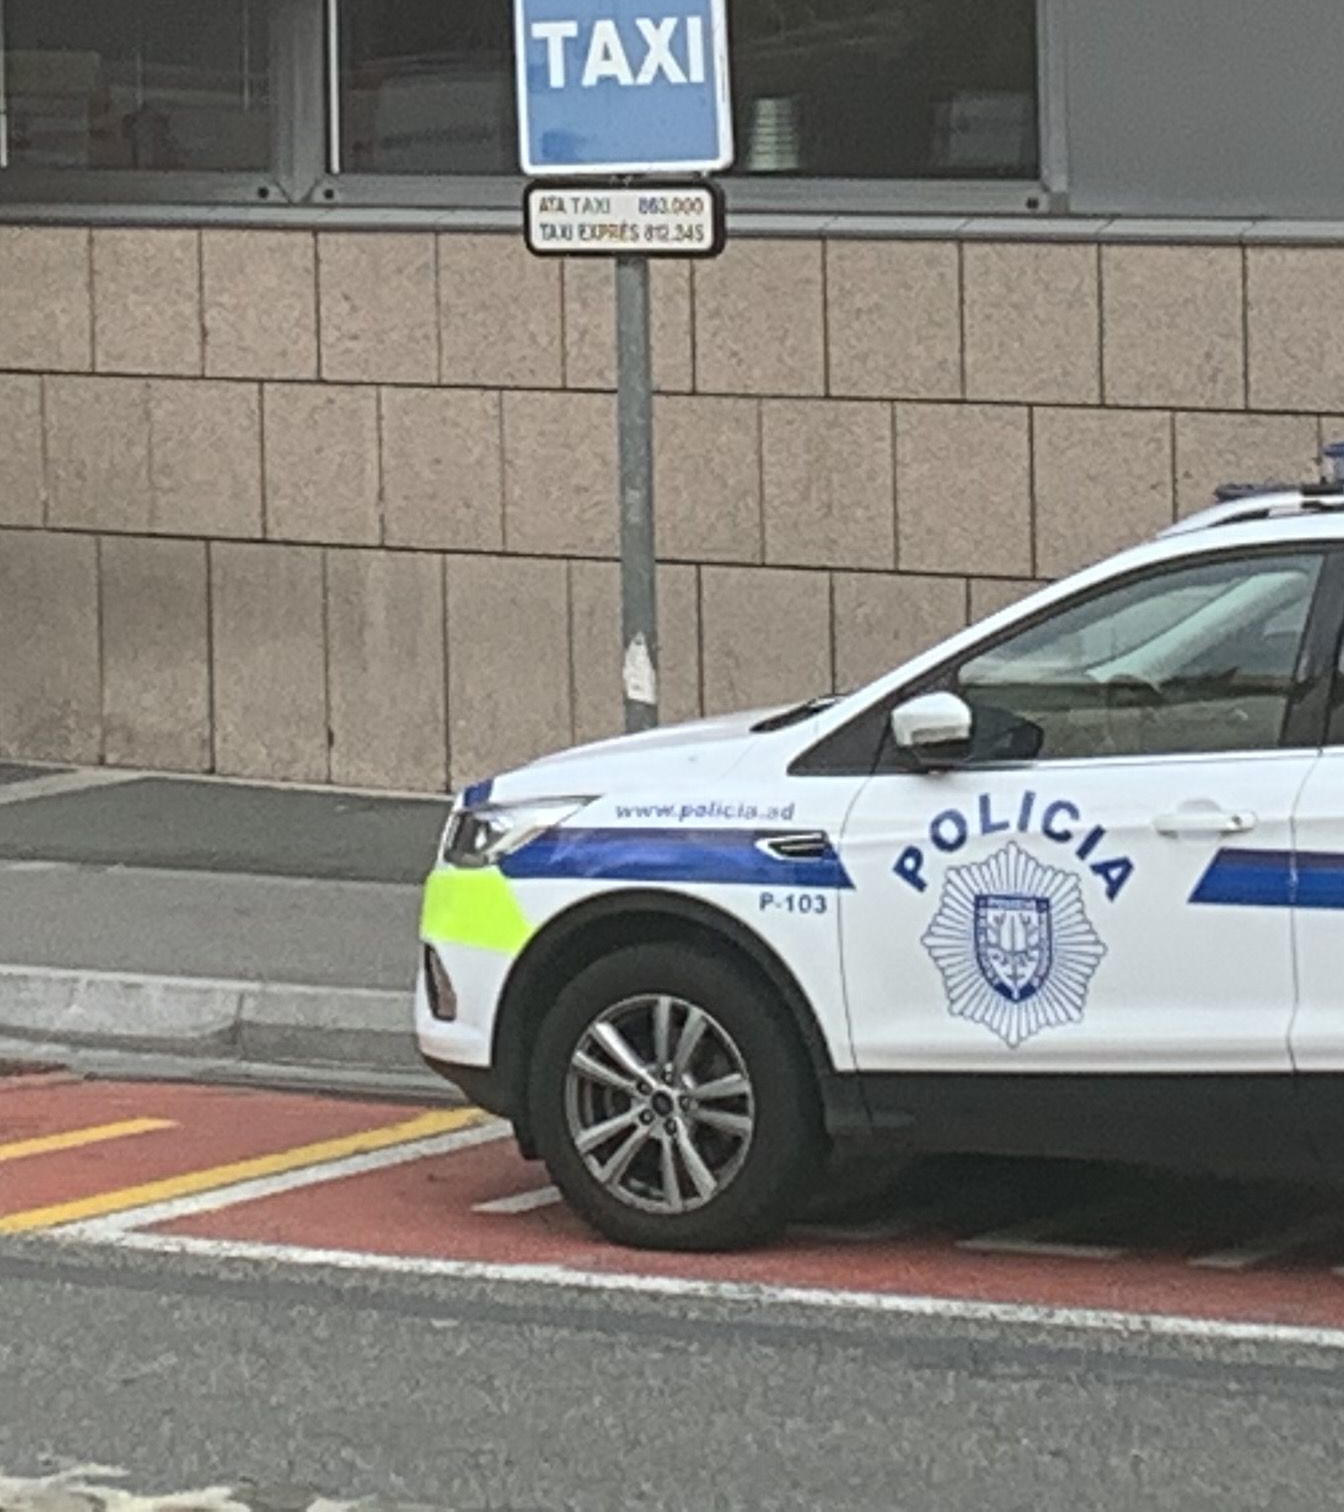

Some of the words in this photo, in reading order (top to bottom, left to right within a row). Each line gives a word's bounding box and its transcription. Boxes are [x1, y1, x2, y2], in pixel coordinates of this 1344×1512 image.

[531, 15, 706, 89] TAXI
[570, 196, 611, 215] TAXI
[539, 223, 574, 242] TAXI
[614, 800, 796, 822] www.policia.ad
[892, 790, 1135, 904] POLICIA
[759, 891, 829, 915] P-103
